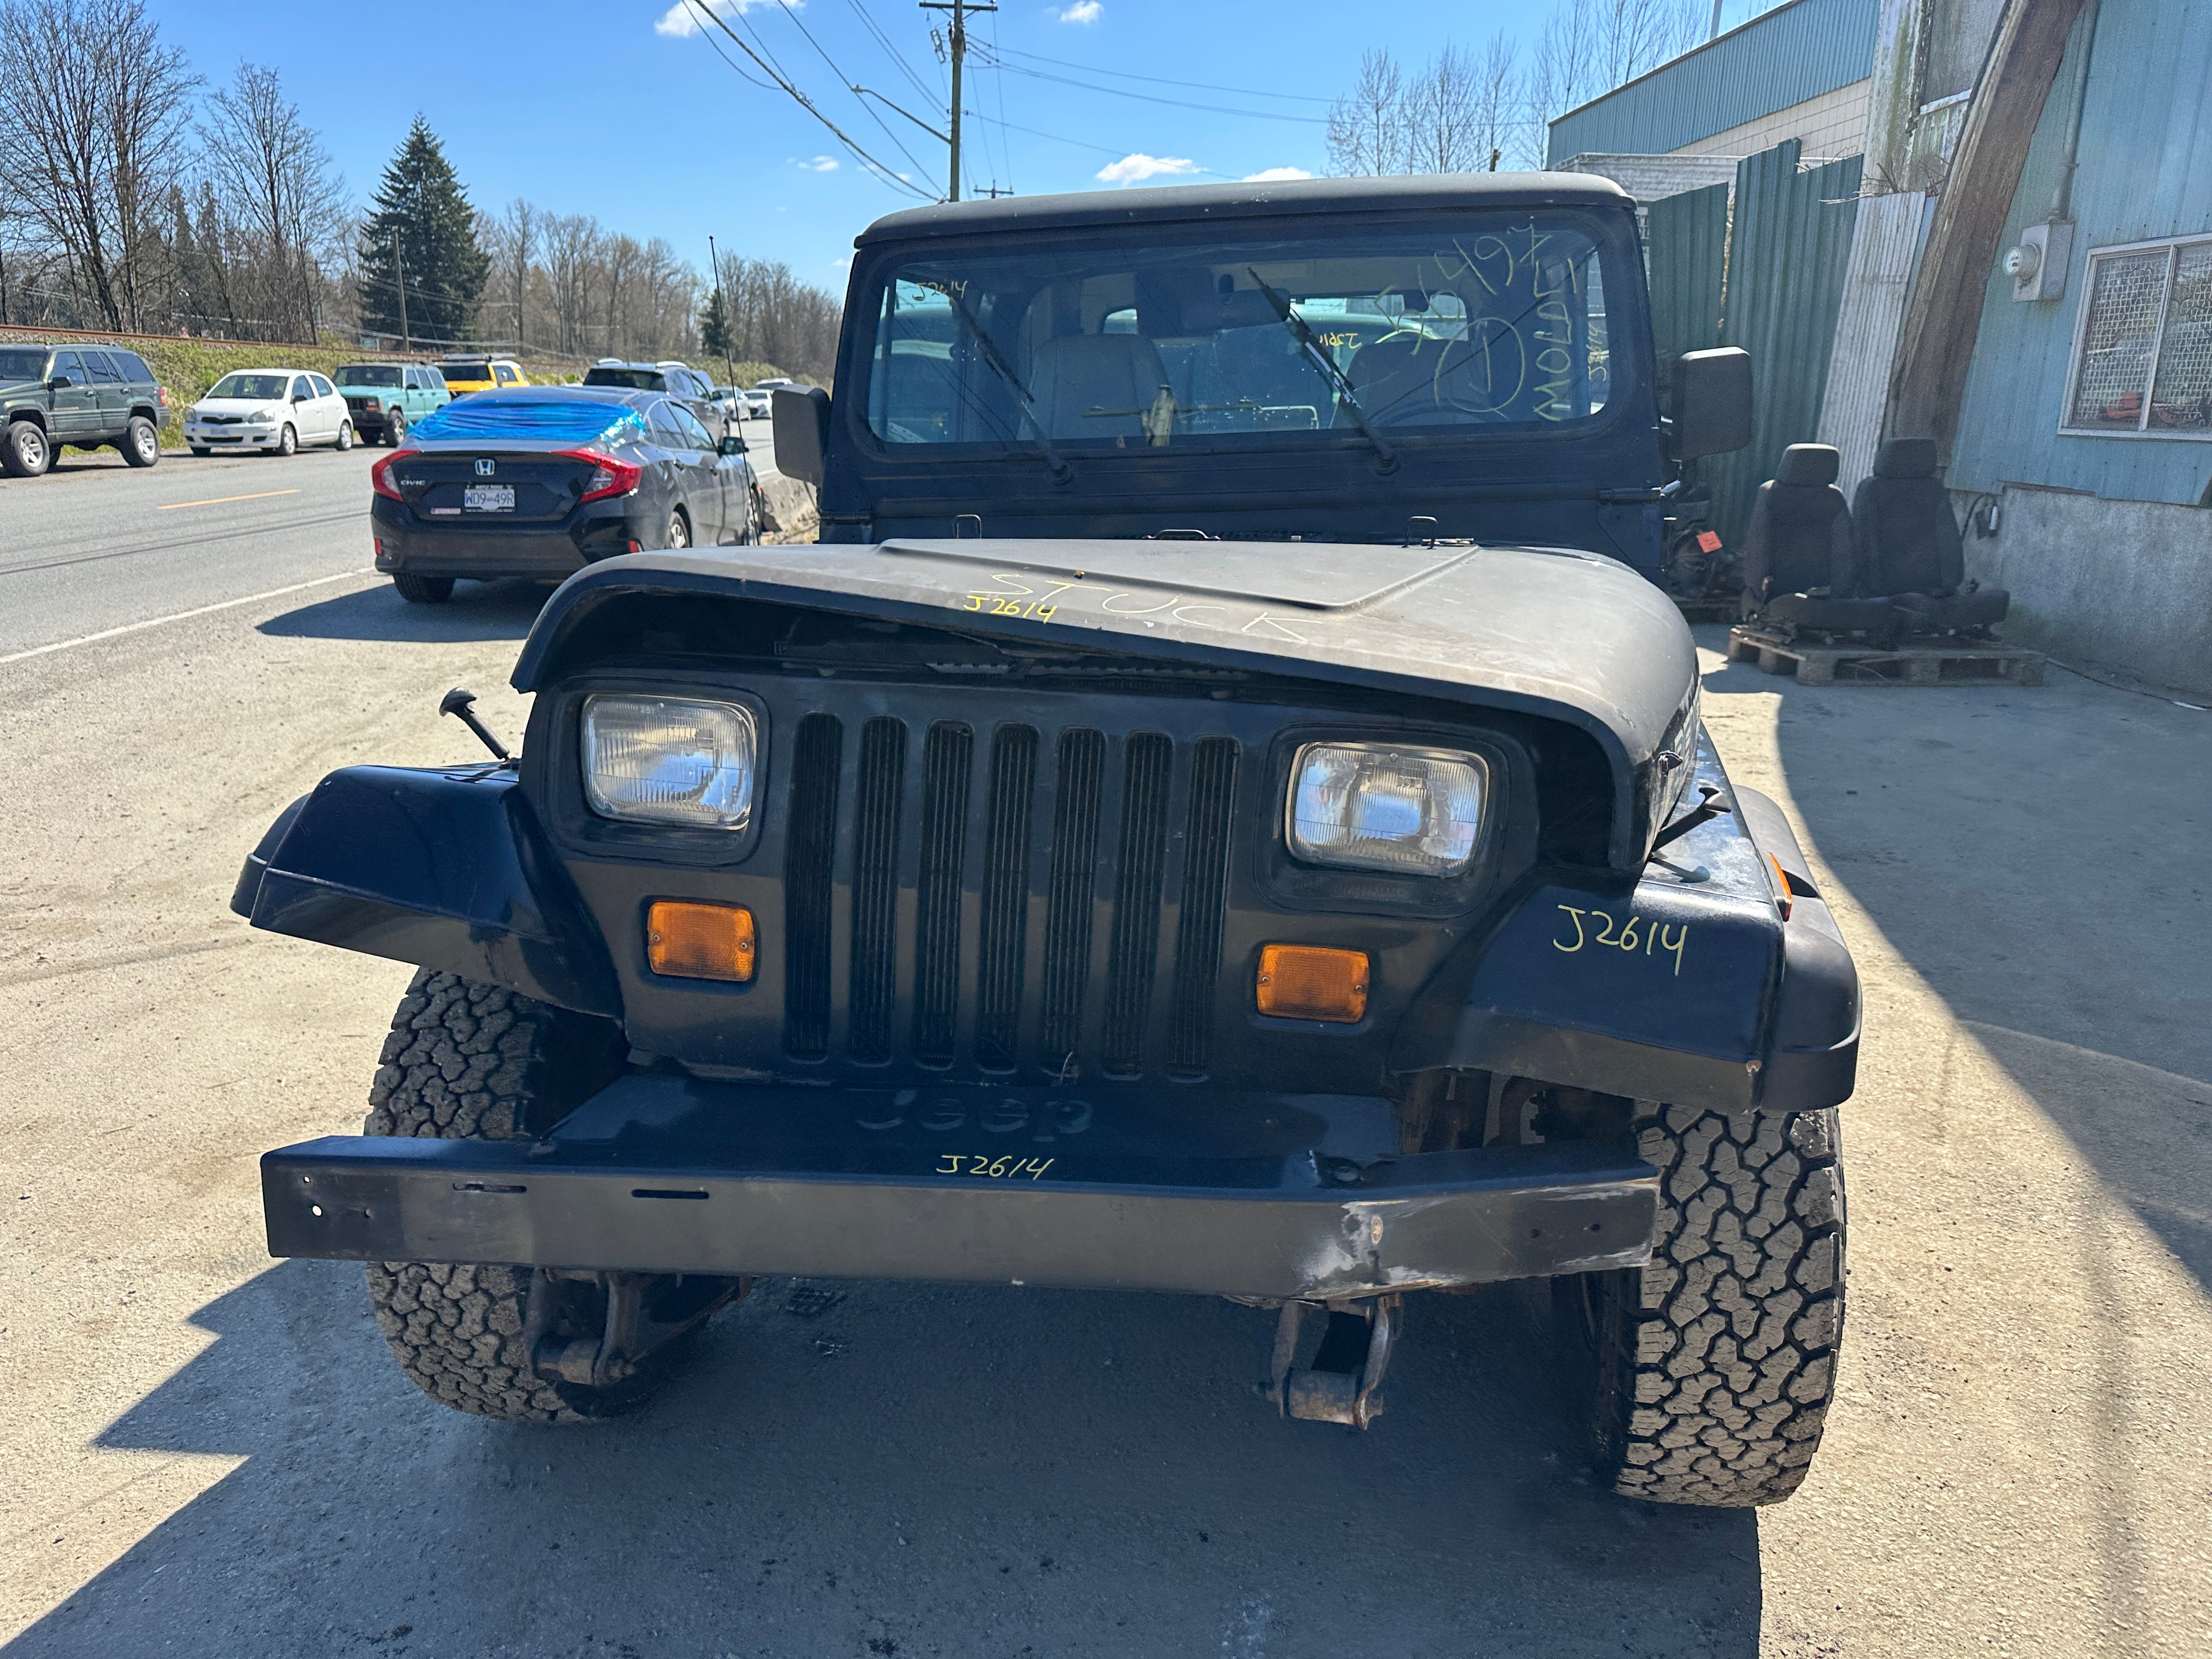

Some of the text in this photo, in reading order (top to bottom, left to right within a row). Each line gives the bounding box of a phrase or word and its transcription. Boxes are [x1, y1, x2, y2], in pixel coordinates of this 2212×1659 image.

[963, 594, 1059, 624] J2614
[1552, 904, 1688, 976] J2614
[855, 1088, 1093, 1143] Jeep
[935, 1154, 1055, 1181] J2614
